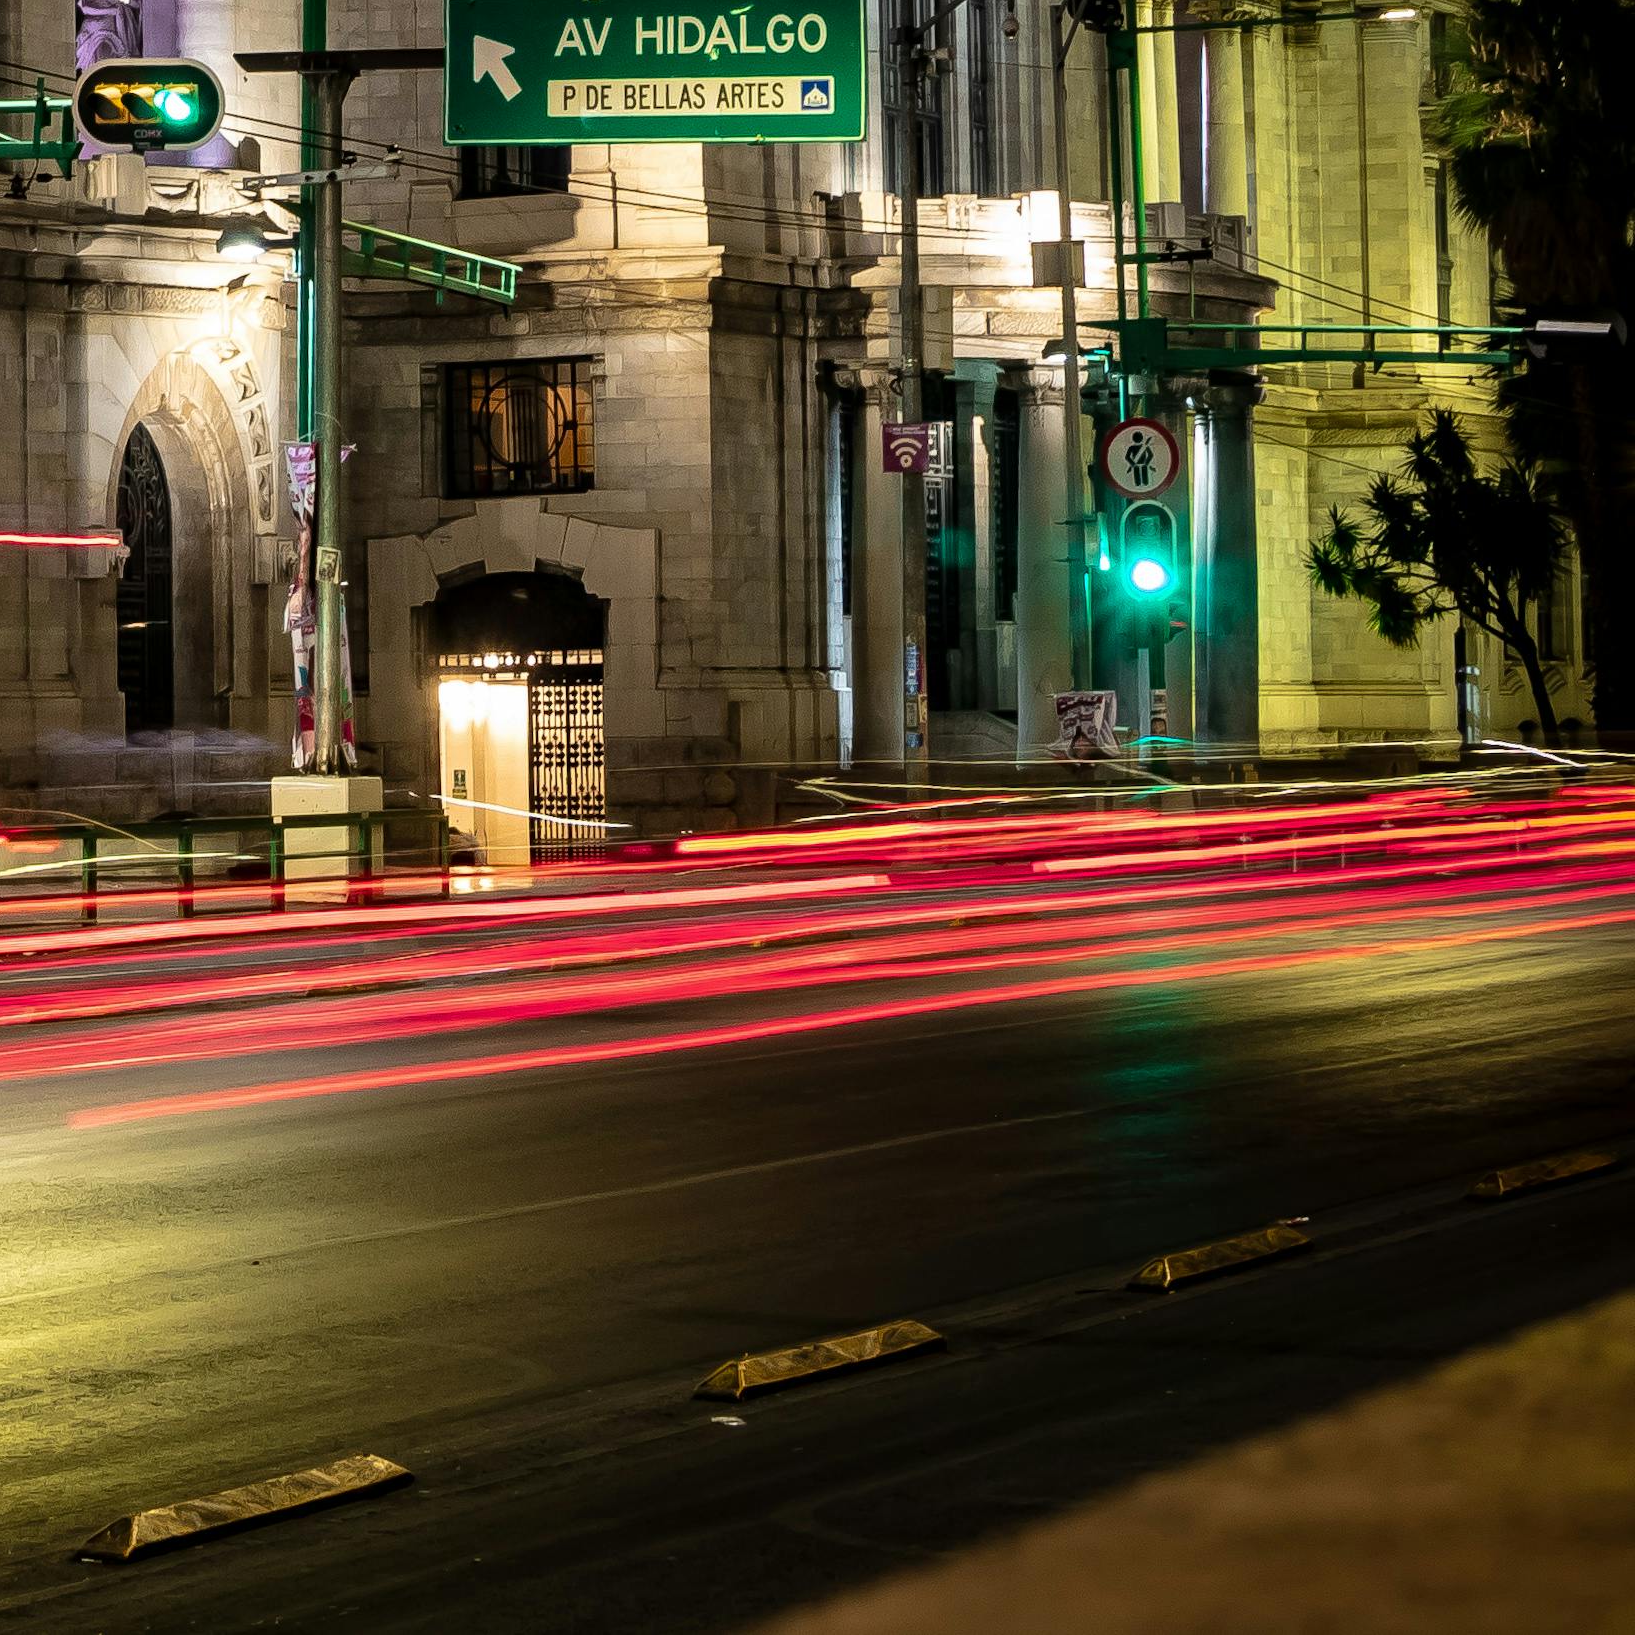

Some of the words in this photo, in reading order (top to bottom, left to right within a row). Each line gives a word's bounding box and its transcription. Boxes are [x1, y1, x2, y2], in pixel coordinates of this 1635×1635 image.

[554, 17, 613, 57] AV
[563, 87, 576, 110] P
[586, 86, 612, 110] DE
[625, 84, 705, 109] BELLAS
[716, 82, 784, 108] ARTES
[134, 130, 162, 138] CDMX
